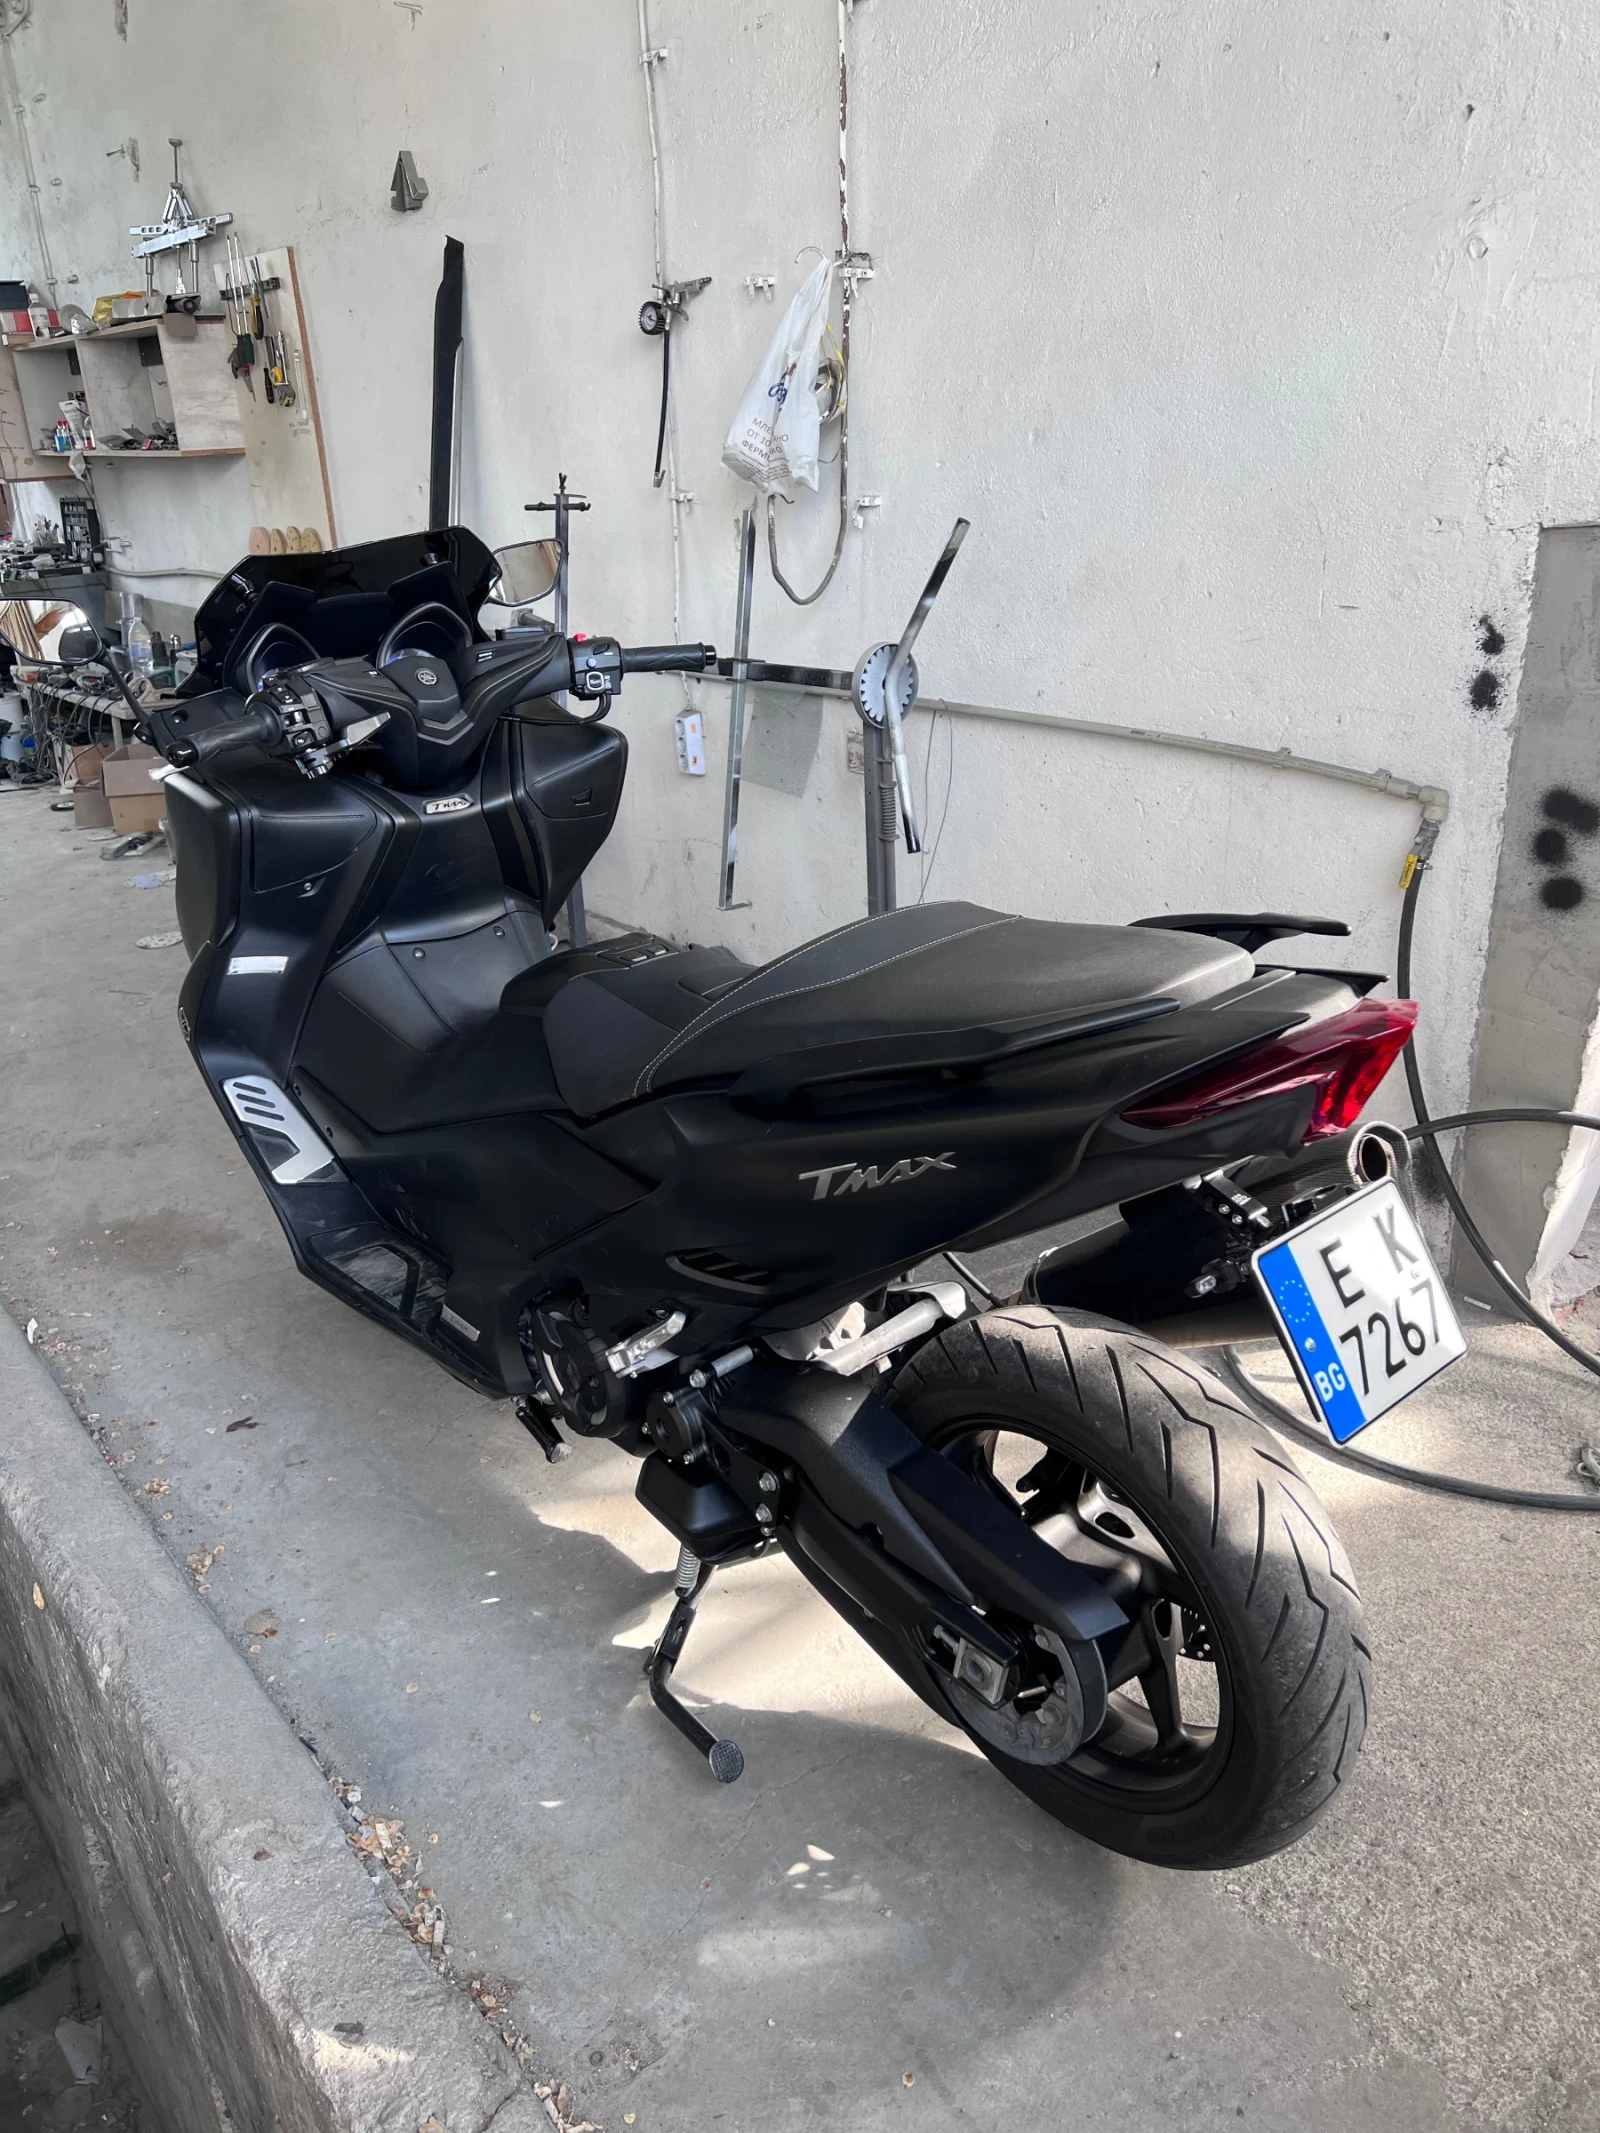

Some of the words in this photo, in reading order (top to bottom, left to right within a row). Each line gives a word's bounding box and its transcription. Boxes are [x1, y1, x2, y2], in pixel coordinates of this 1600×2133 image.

[747, 428, 760, 440] ОТ
[752, 417, 774, 436] МЛЕ
[798, 1152, 958, 1201] TMAX
[1318, 1235, 1366, 1309] E
[1371, 1203, 1420, 1273] K
[1338, 1276, 1441, 1396] 7267
[1313, 1362, 1346, 1403] BG
